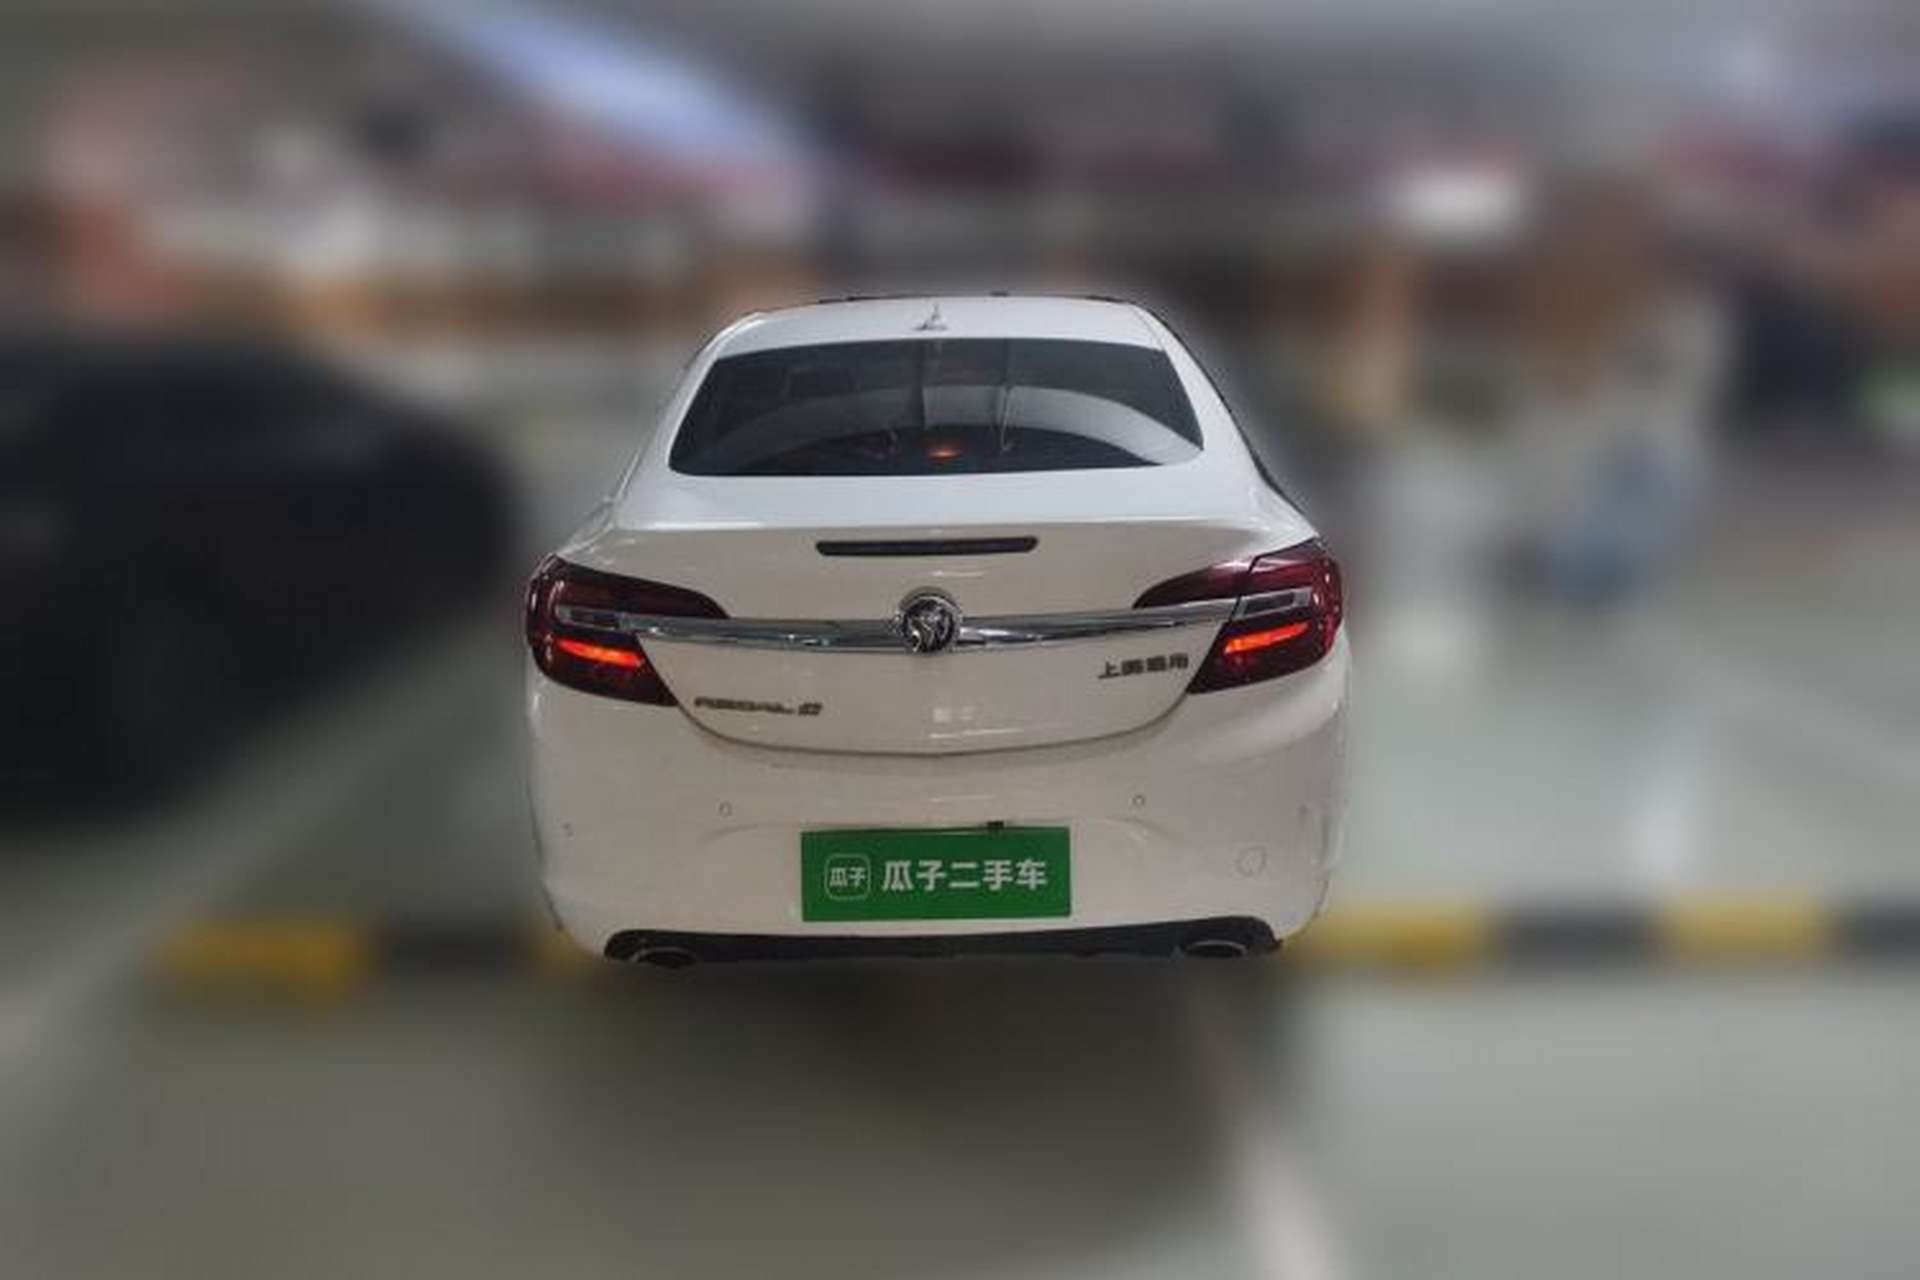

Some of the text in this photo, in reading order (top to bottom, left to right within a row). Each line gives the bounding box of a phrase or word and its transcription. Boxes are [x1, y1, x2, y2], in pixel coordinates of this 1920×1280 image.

[829, 866, 866, 888] 瓜子
[882, 859, 1048, 891] 瓜子二手车
